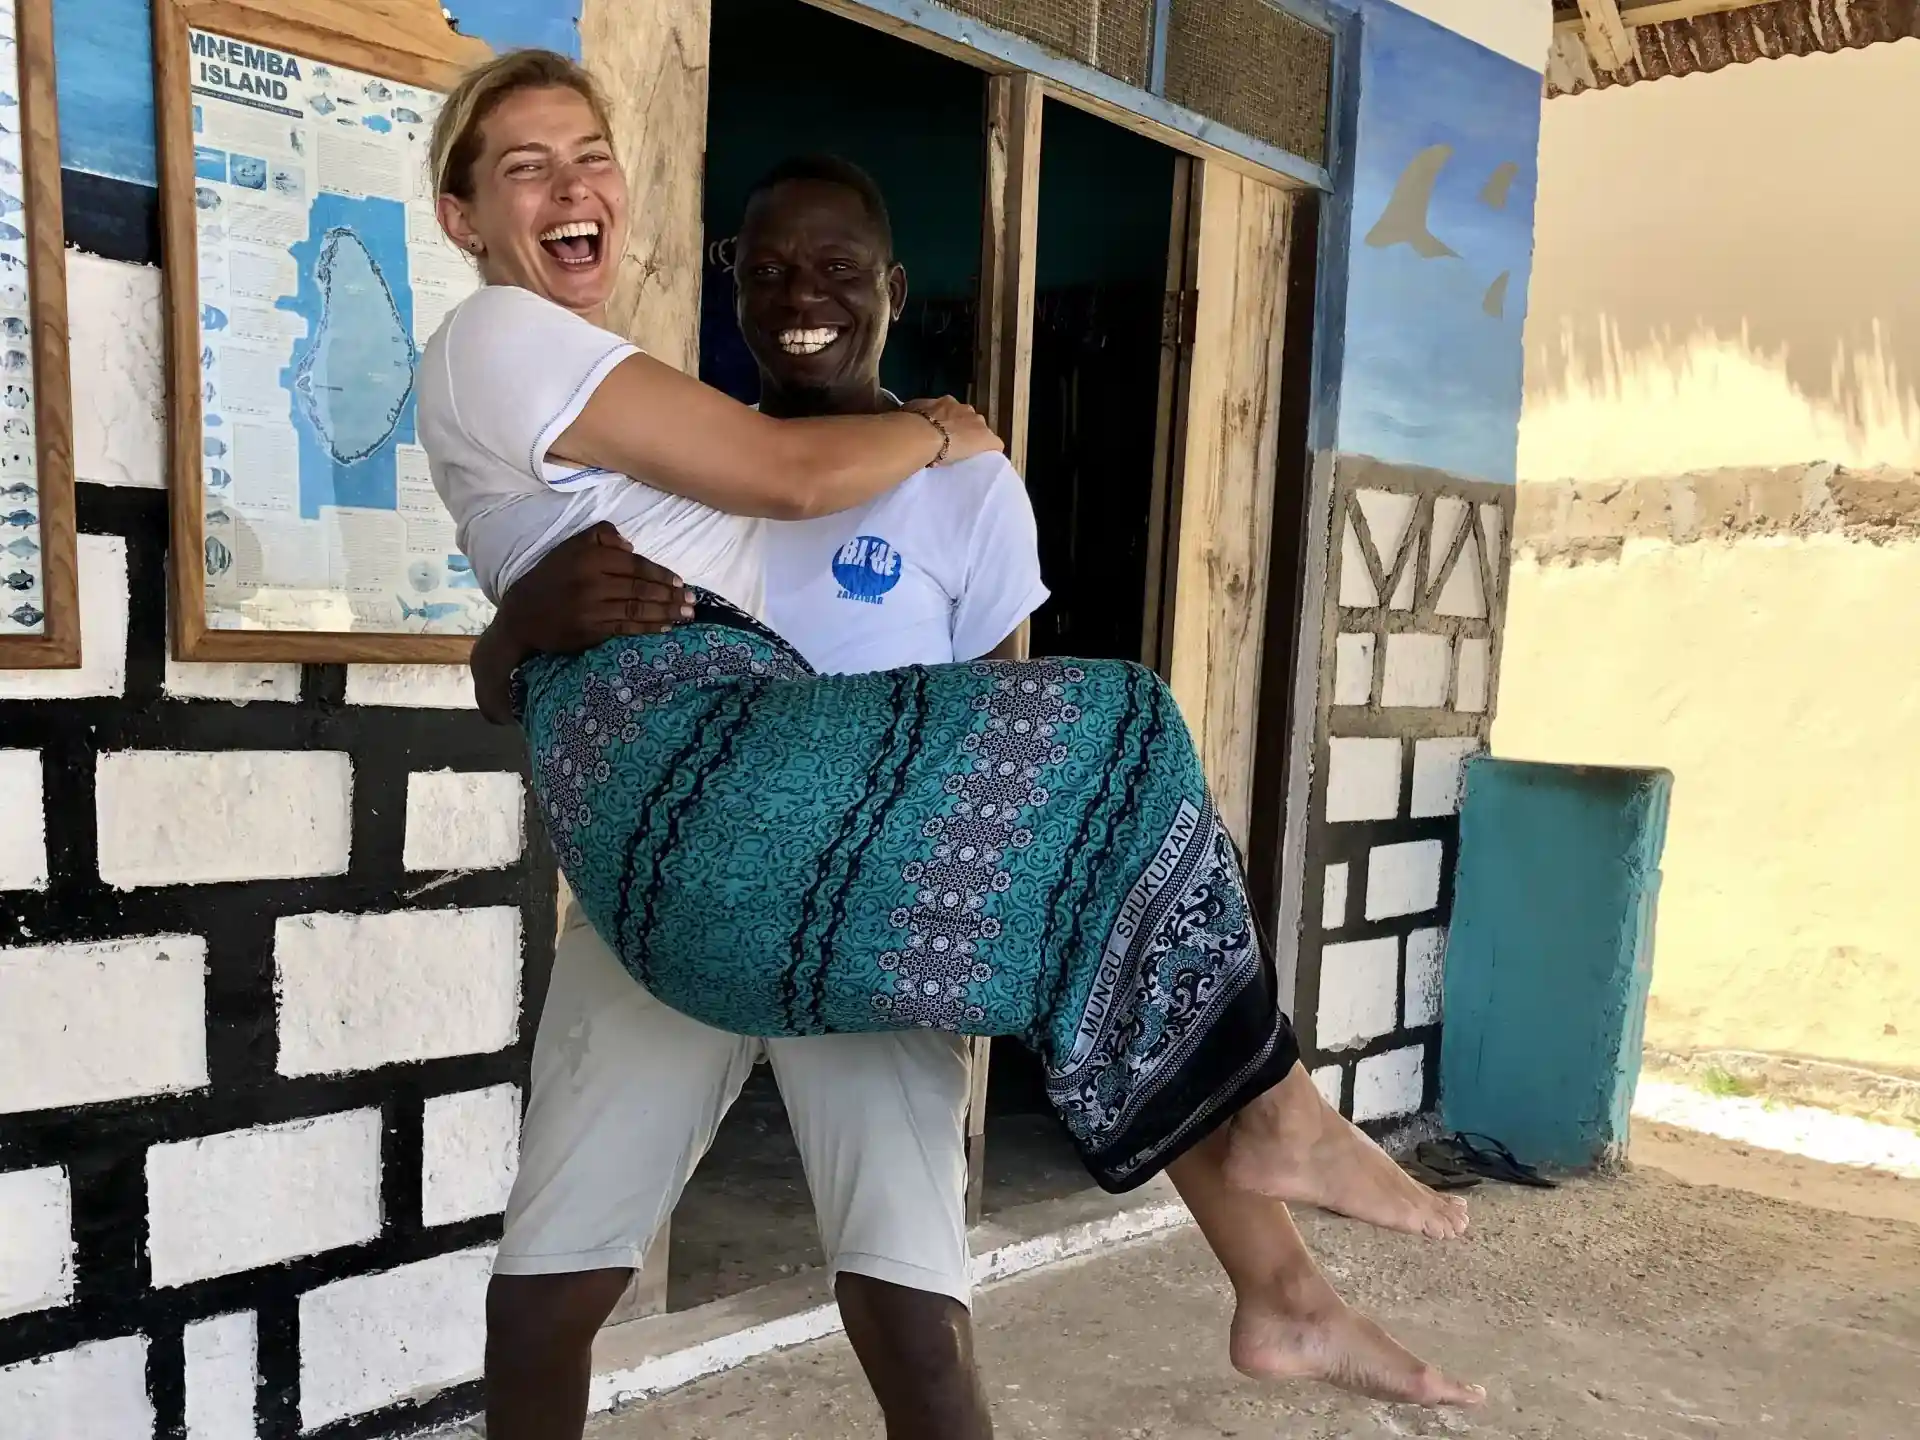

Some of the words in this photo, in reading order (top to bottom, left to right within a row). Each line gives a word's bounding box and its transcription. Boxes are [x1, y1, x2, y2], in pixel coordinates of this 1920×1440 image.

[188, 32, 302, 82] MNEMBA
[200, 61, 288, 101] ISLAND
[1081, 949, 1122, 1040] MUNGU
[1116, 810, 1196, 939] SHUKURANI
